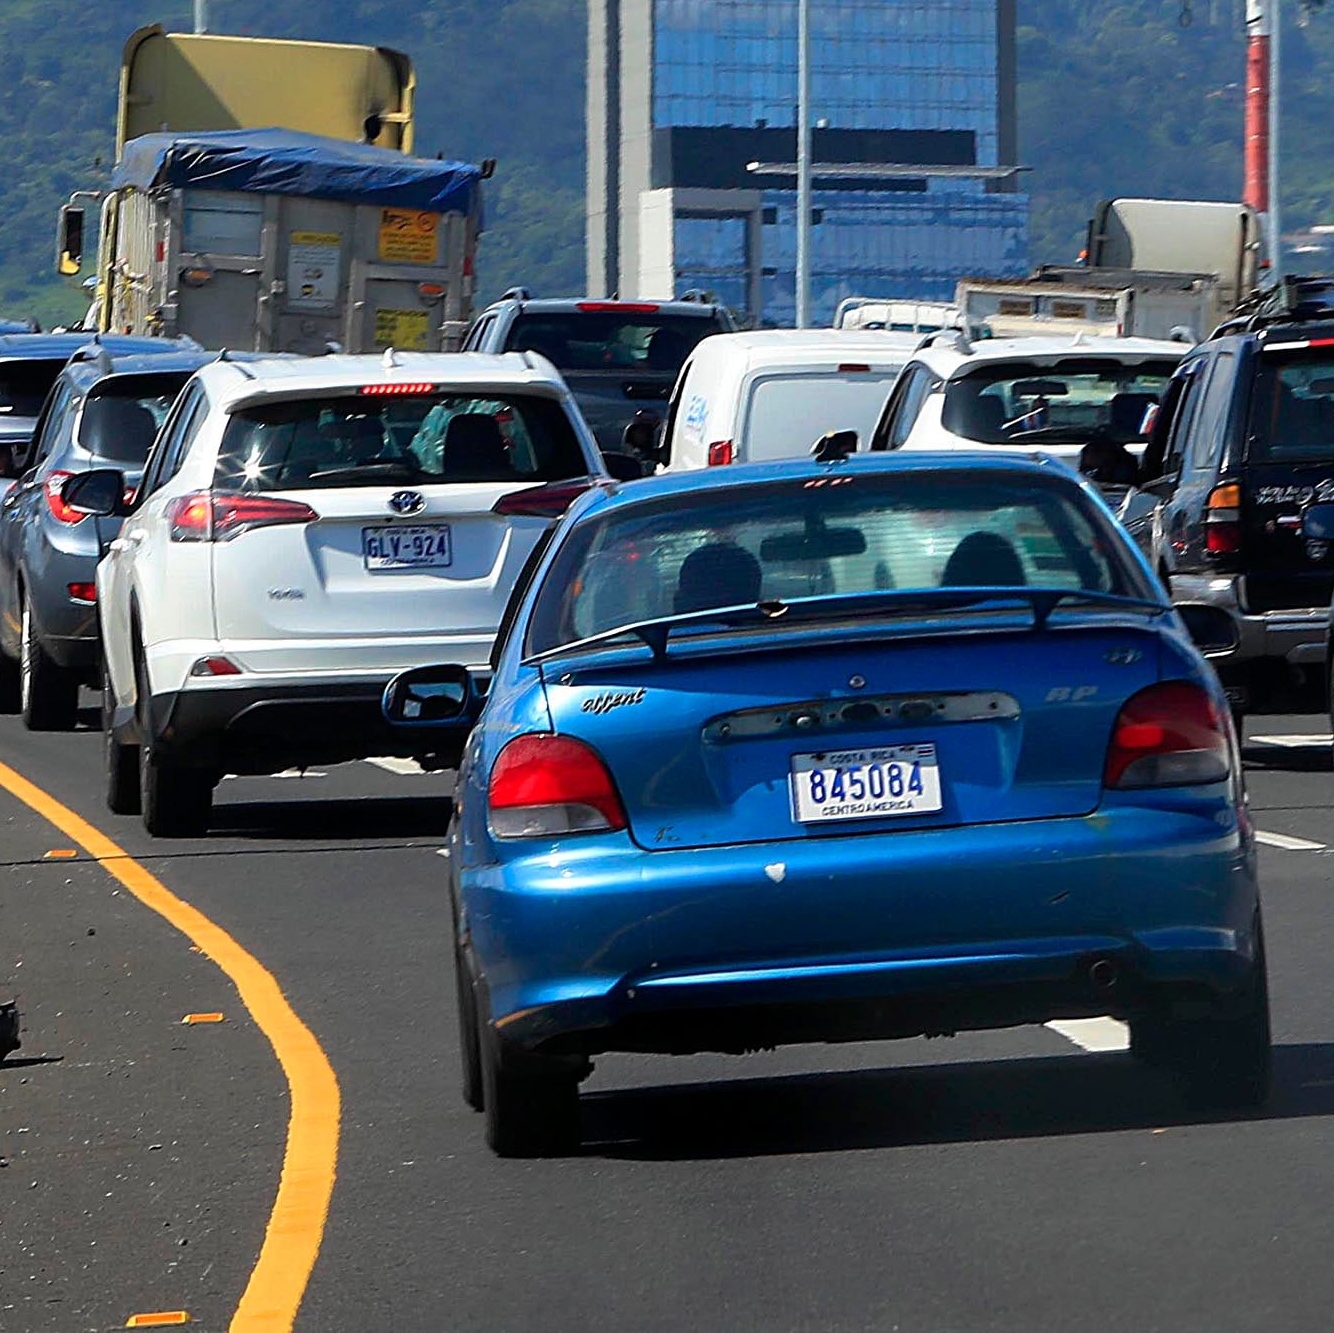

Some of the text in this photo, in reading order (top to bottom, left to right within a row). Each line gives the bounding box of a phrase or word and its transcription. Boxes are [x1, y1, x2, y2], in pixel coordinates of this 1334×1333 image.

[829, 749, 896, 765] COSTA RICA
[809, 760, 924, 805] 845084
[821, 799, 915, 816] CENTROAMERICA
